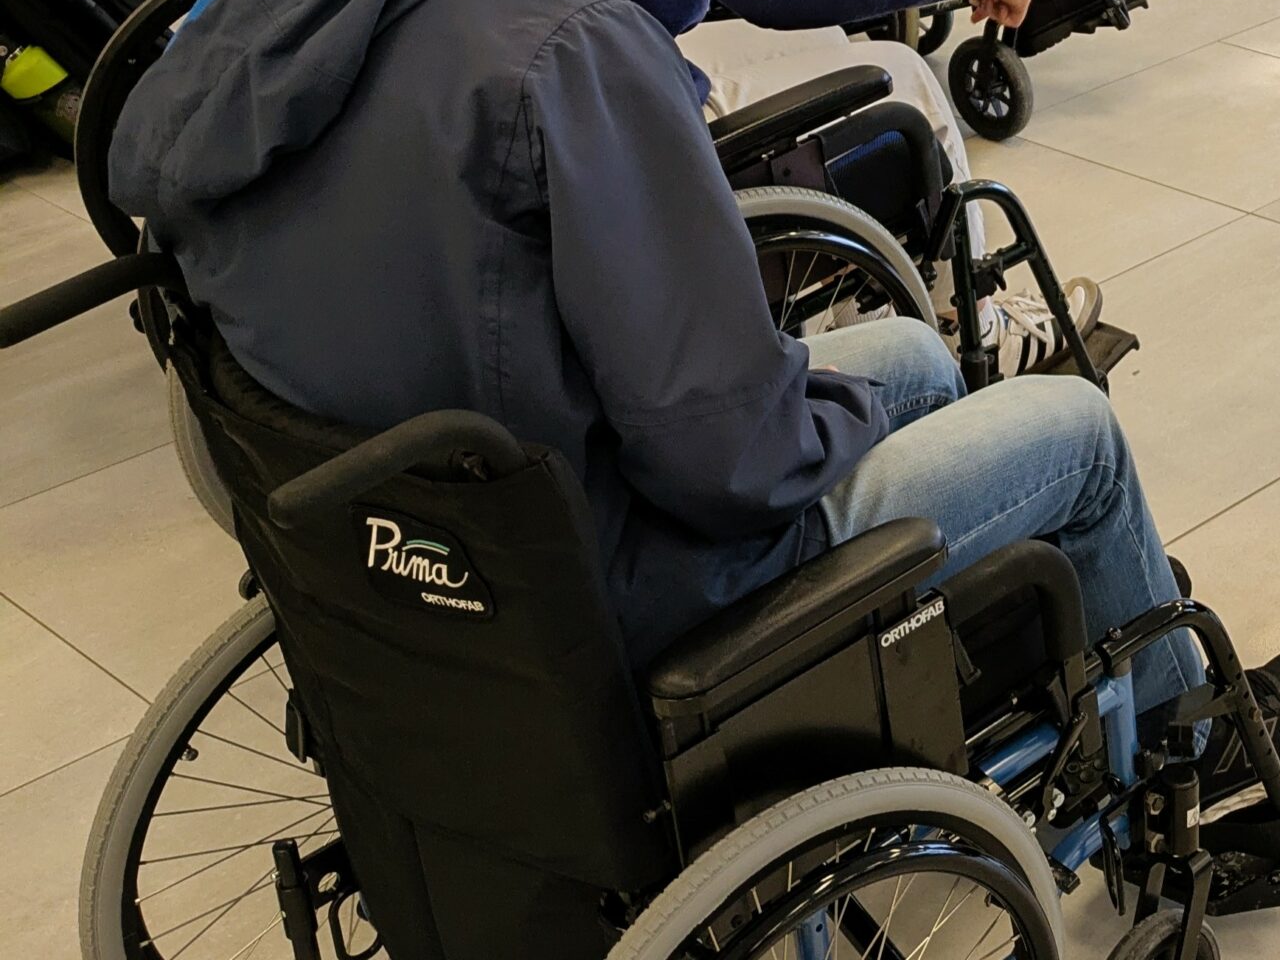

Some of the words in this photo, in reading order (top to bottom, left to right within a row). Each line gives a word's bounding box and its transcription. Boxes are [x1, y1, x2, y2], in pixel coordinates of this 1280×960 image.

[365, 516, 469, 588] Prima
[421, 592, 484, 612] ORTHOFAB
[880, 600, 945, 648] ORTHOFAB
